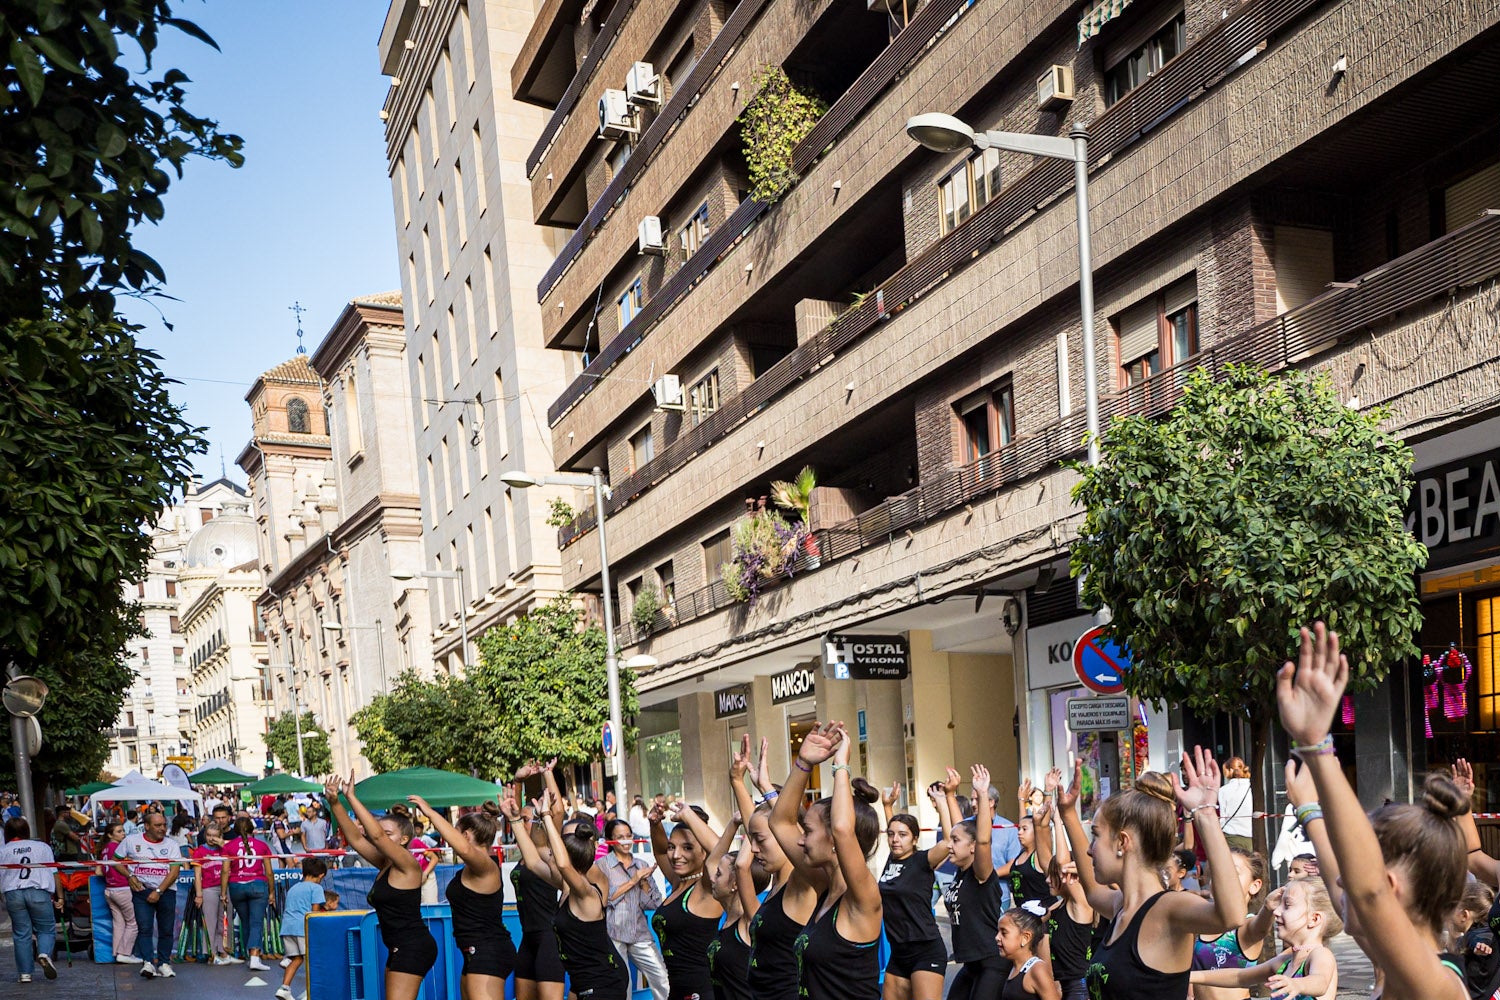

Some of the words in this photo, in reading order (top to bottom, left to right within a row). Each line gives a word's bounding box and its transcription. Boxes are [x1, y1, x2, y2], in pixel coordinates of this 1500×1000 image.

[826, 643, 904, 664] HOSTAL
[1048, 640, 1077, 665] KO
[772, 669, 809, 699] MANGO
[272, 871, 303, 882] ockey
